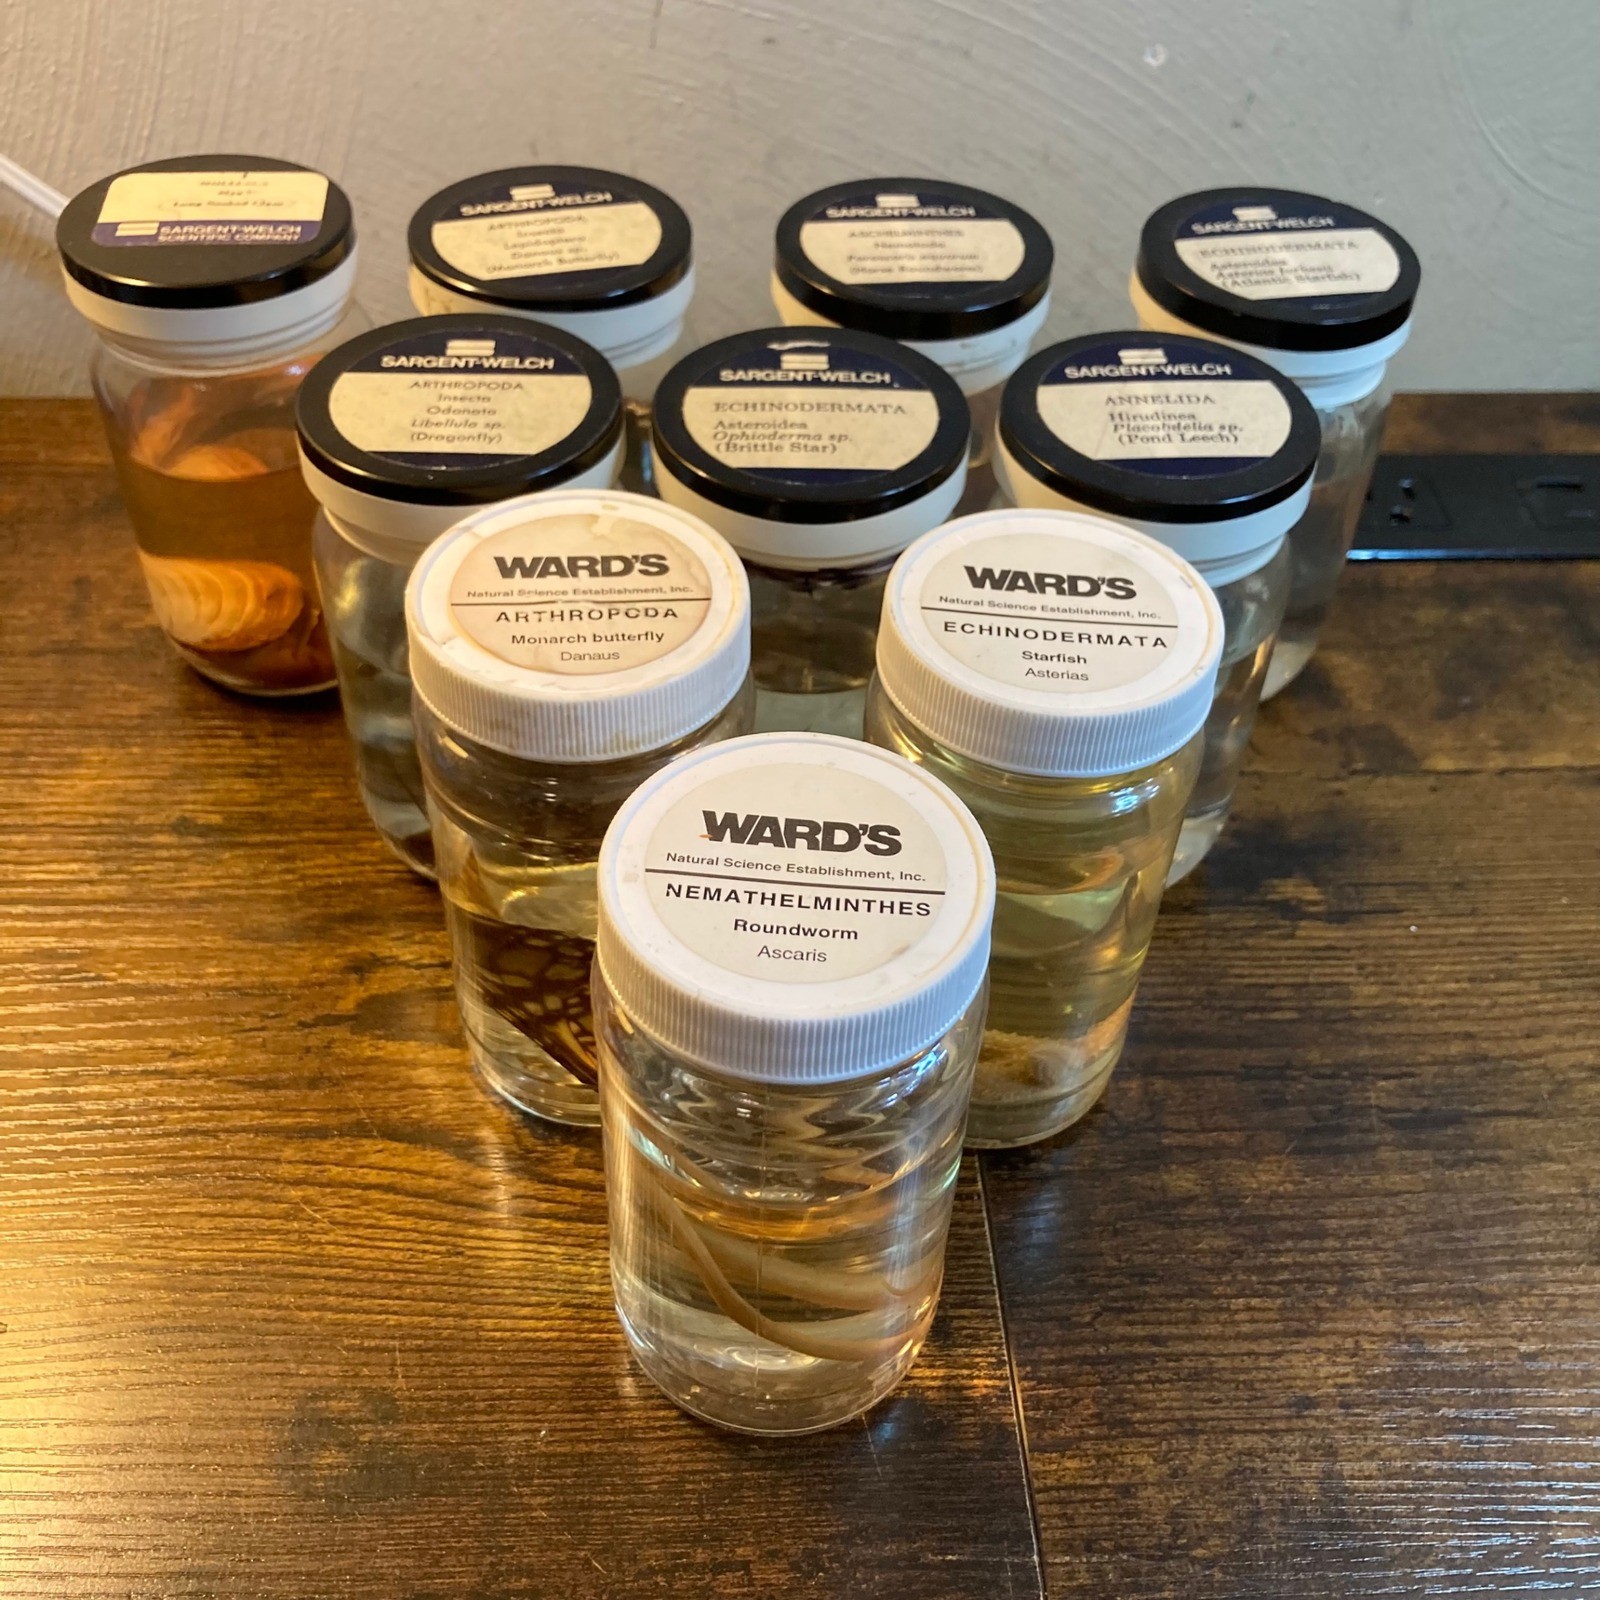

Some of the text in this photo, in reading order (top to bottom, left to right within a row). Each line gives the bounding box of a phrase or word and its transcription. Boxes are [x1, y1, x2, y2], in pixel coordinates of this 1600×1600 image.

[460, 191, 613, 216] SARGENT-WELCH
[825, 205, 976, 218] SARGENT-WELCH
[160, 224, 302, 235] SARGENT-WELCH
[1192, 215, 1335, 235] SARGENT-WELCH
[380, 355, 555, 370] SARGENT-WELCH
[719, 369, 891, 384] SARGENT-WELCH
[1064, 363, 1232, 378] SARGENT-WELCH
[410, 380, 525, 391] ARTHROPODA
[437, 394, 491, 403] Insecta
[1105, 395, 1216, 406] ANNELIDA
[426, 405, 497, 416] Odonata
[713, 402, 906, 415] ECHINODERMATA
[411, 418, 506, 432] Libellula sp.
[713, 419, 808, 430] Asteroidea
[1218, 423, 1243, 434] sp.
[410, 432, 502, 444] (Dragonfly)
[713, 431, 853, 444] Ophioderma sp.
[1118, 432, 1239, 445] (Pond Leech)
[716, 442, 838, 454] (Brittle Star)
[493, 554, 670, 579] WARD'S
[963, 565, 1137, 600] WARD'S
[467, 585, 694, 598] Natural Science Establishment, Inc.
[939, 595, 1162, 620] Natural Science Establishment, Inc.
[511, 631, 665, 645] Monarch butterfly
[944, 621, 1168, 649] ECHINODERMATA
[560, 650, 620, 662] Danaus
[1022, 650, 1087, 664] Starfish
[1025, 667, 1089, 682] Asterias
[702, 810, 902, 857] WARD'S
[666, 852, 926, 883] Natural Science Establishment, Inc.
[665, 883, 931, 917] NEMATHELMINTHES
[733, 918, 859, 940] Roundworm
[757, 945, 827, 963] Ascaris
